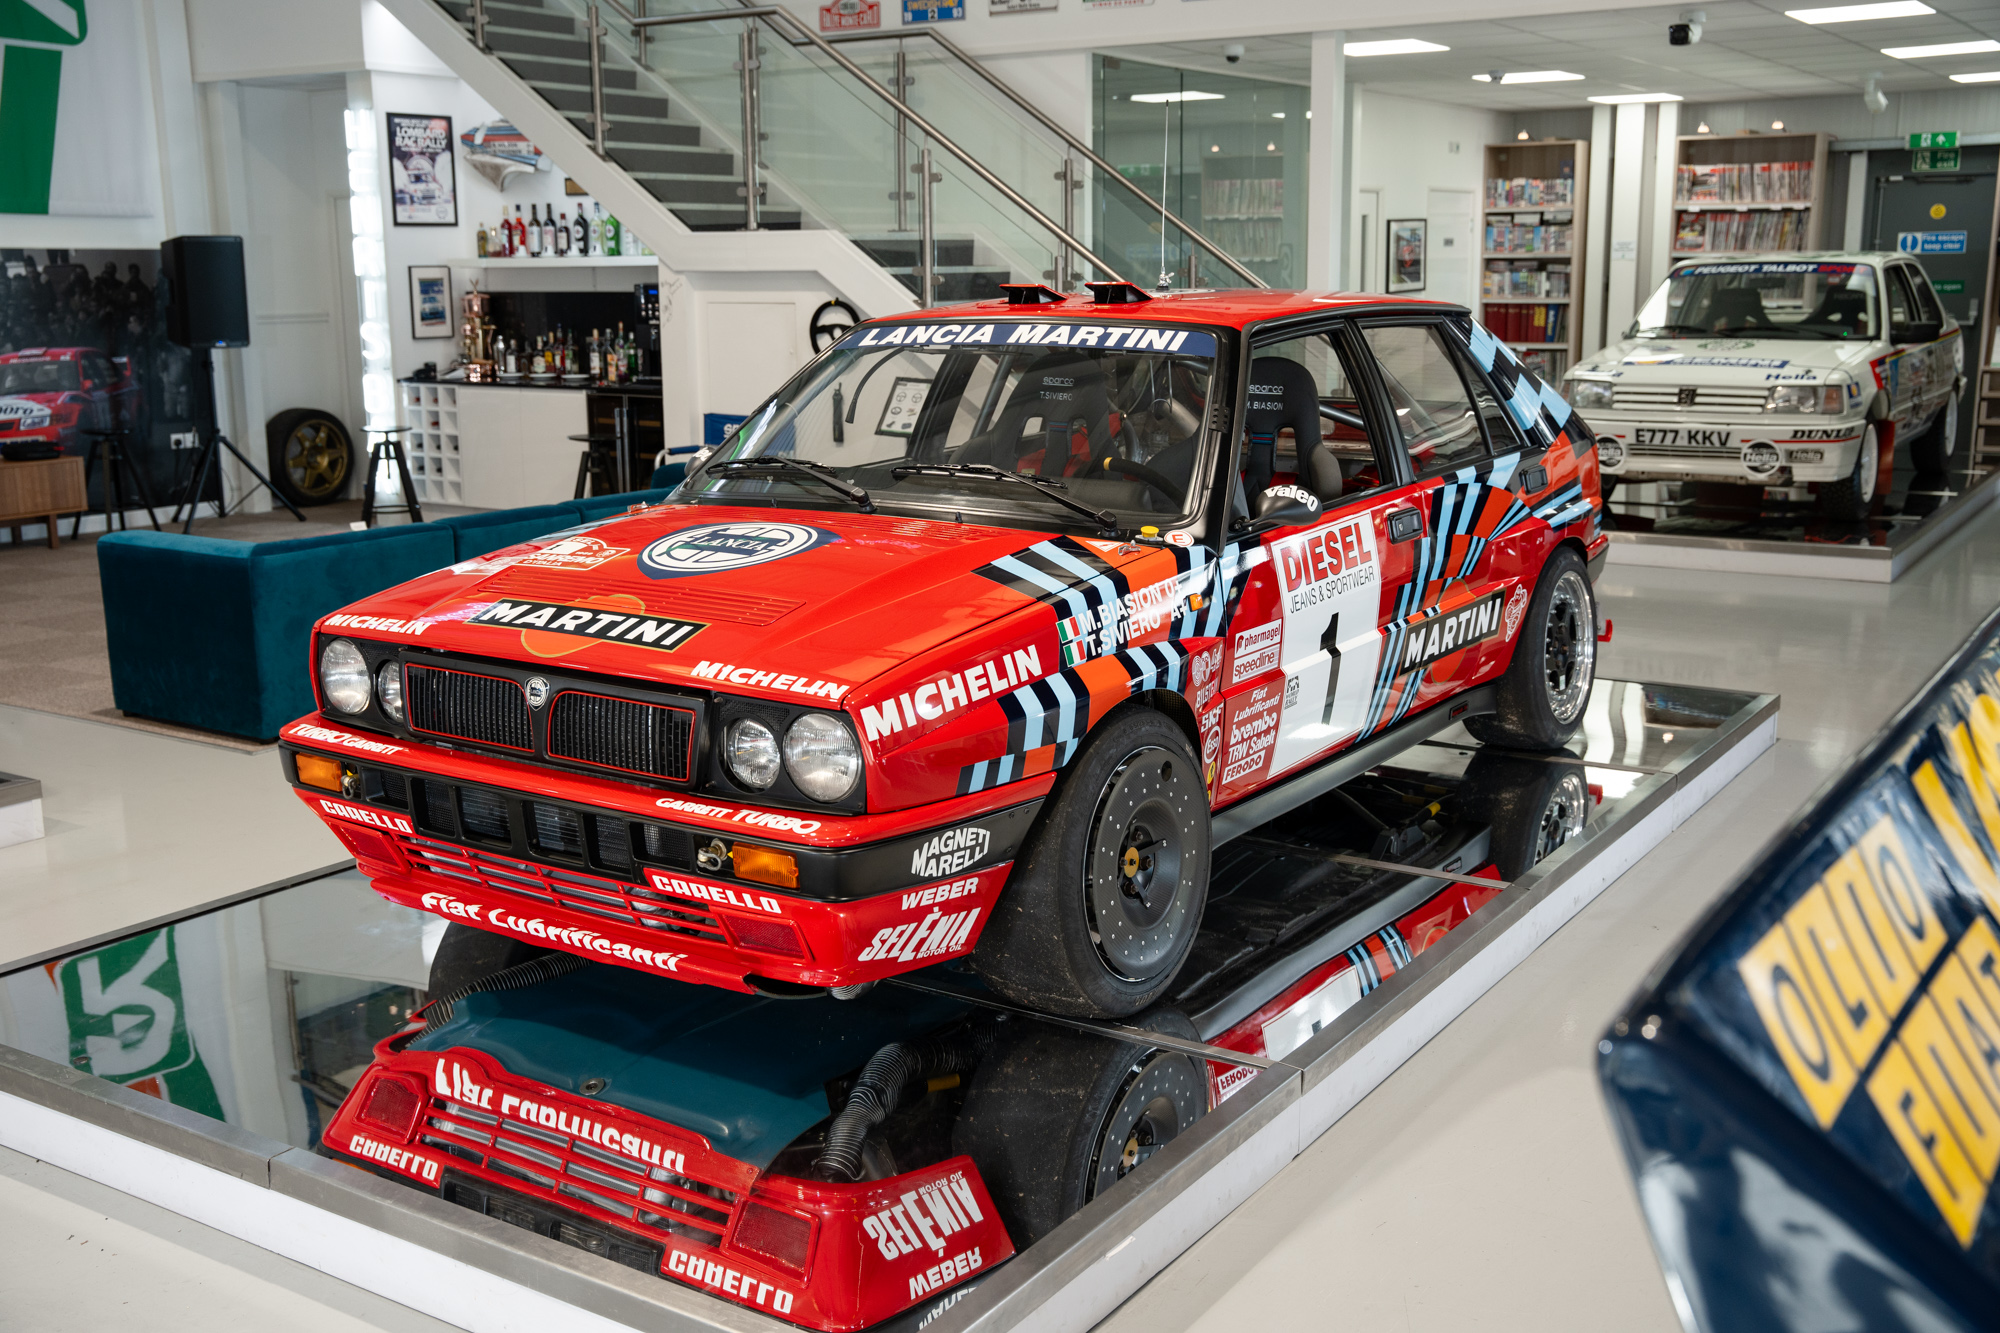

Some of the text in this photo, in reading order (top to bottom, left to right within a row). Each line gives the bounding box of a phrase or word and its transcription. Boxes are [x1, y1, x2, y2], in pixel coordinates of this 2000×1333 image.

[396, 126, 446, 139] LOMBARD
[1694, 264, 1759, 275] PEUGEOT
[1761, 263, 1818, 274] TALBOT
[858, 323, 1189, 352] LANCIA MARTINI
[1042, 376, 1075, 387] sparco
[1248, 384, 1284, 395] sparco
[1253, 401, 1284, 411] BIASION
[1635, 428, 1731, 447] E777 KKV
[1745, 452, 1778, 462] Hella
[1263, 484, 1319, 512] valeo
[693, 535, 769, 551] LANCIA
[1171, 533, 1187, 545] E
[1279, 522, 1373, 593] DIESEL
[1289, 564, 1376, 615] JEANS & SPORTWEAR
[324, 613, 429, 637] MICHELIN
[482, 602, 686, 649] MARTINI
[1244, 623, 1281, 651] pharmagel
[1404, 597, 1502, 669] MARTINI
[1234, 651, 1275, 680] speedline
[1318, 611, 1342, 726] 1
[690, 660, 850, 703] MICHELIN
[860, 644, 1043, 742] MICHELIN
[1250, 686, 1268, 703] Fiat
[1200, 702, 1224, 734] SKF
[1233, 692, 1282, 723] Lubrificanti
[288, 723, 404, 756] TURBO GARRETT
[1229, 711, 1278, 746] brembo
[1206, 735, 1219, 755] Esso
[1228, 728, 1276, 765] TRW Sabelt
[1224, 754, 1262, 782] FERODO
[319, 799, 413, 834] CARELLO
[655, 797, 822, 835] GARRETT TURBO
[911, 828, 991, 870] MAGNETI
[911, 843, 989, 877] MARELLI
[651, 873, 783, 915] CARELLO
[901, 876, 979, 911] WEBER
[421, 891, 688, 972] Fiat Lubrificanti
[916, 943, 962, 960] MOTOR OIL
